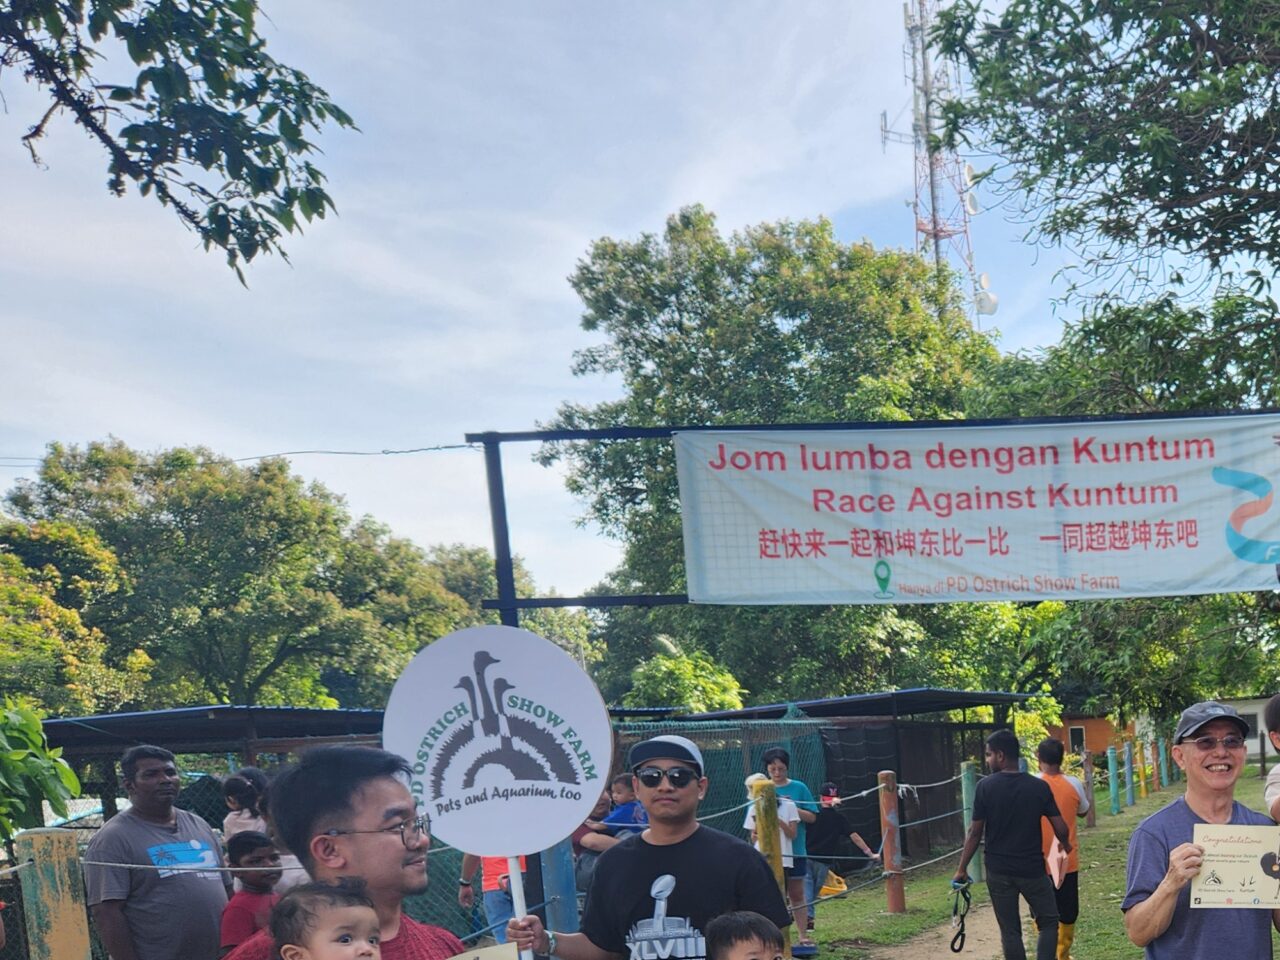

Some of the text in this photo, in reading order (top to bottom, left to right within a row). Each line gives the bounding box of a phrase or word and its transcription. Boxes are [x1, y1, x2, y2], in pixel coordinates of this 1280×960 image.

[708, 434, 1215, 475] Jom lumba dengan Kuntum
[812, 481, 1178, 518] Race Against Kuntum
[758, 518, 1199, 559] 赶快来一起和坤东比一比 一同超越坤东吧
[946, 576, 968, 593] PD
[973, 574, 1031, 593] Ostrich
[1033, 575, 1077, 593] Show
[1081, 573, 1120, 592] Farm
[413, 701, 470, 776] OSTRICH
[506, 694, 565, 728] SHOW
[561, 726, 599, 781] FARM
[435, 798, 461, 816] Pets
[464, 787, 488, 806] and
[560, 786, 582, 801] too
[624, 936, 707, 960] XLVIII
